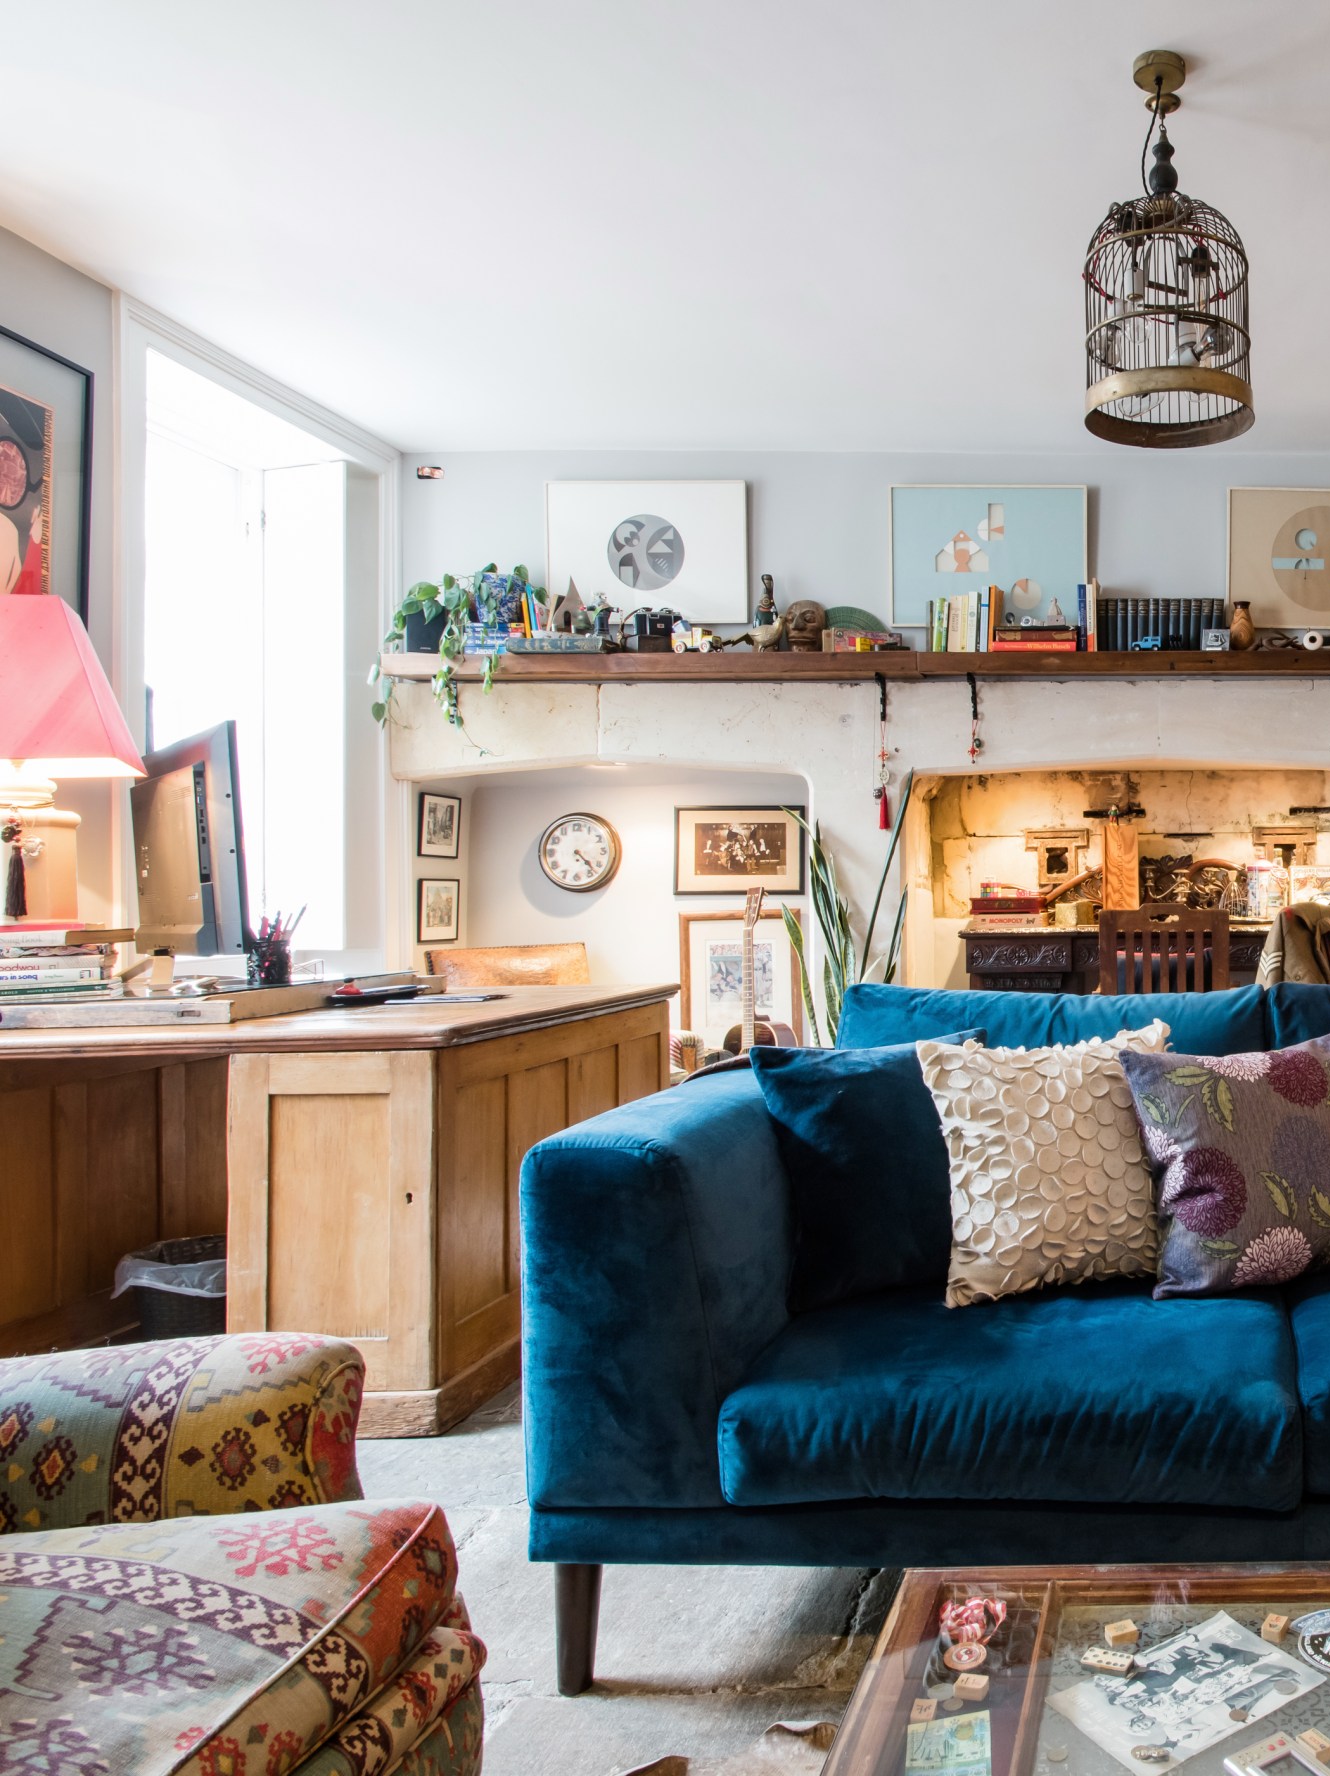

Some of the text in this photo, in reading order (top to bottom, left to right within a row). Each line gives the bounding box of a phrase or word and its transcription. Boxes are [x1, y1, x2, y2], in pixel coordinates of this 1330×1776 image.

[572, 822, 582, 832] 12
[587, 826, 591, 835] 1
[595, 834, 602, 843] 2
[600, 847, 607, 856] 3
[561, 870, 568, 880] 7
[587, 870, 594, 878] 5
